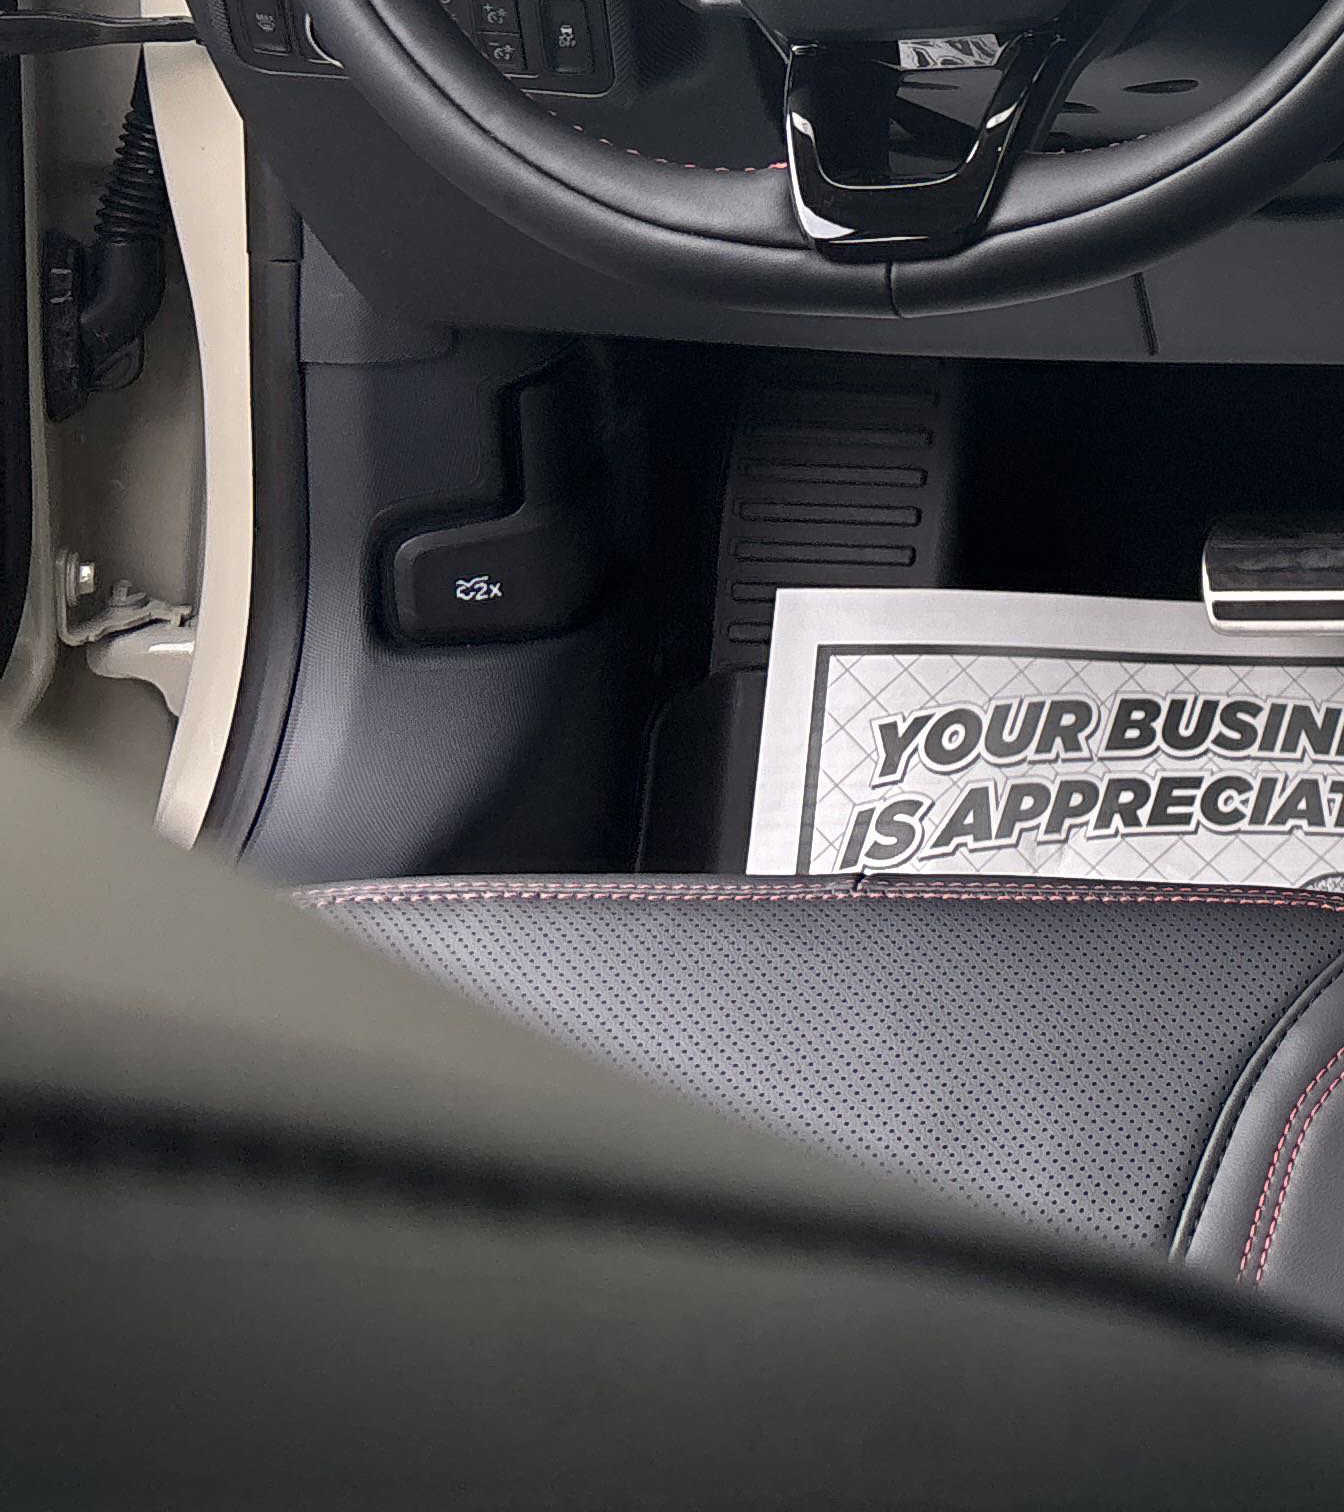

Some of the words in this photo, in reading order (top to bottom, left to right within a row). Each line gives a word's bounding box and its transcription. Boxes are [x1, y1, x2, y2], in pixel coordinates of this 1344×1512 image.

[474, 582, 502, 600] 2x
[875, 695, 1096, 783] YOUR
[841, 798, 931, 871] IS
